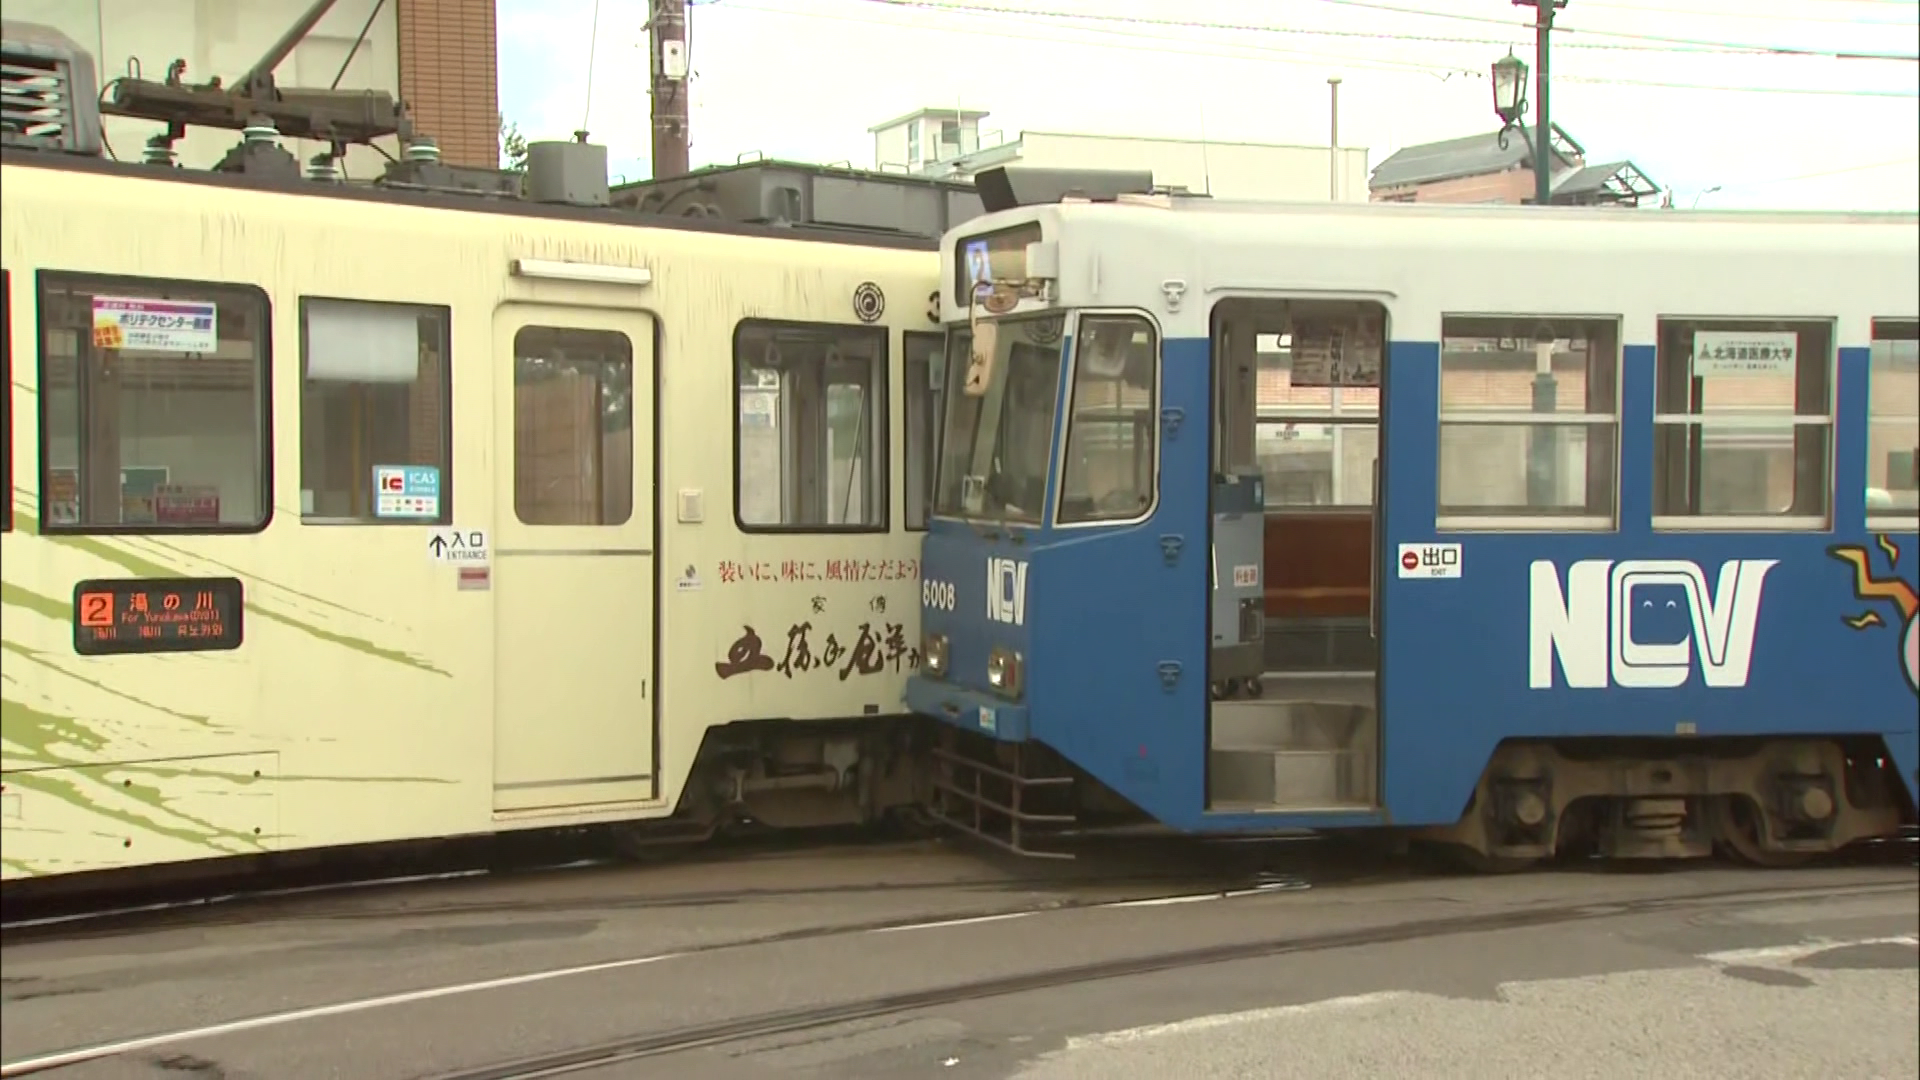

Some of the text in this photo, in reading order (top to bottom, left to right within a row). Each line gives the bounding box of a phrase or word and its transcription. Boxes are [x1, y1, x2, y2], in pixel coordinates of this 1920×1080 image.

[1714, 346, 1793, 361] 北海道医療大学
[410, 472, 436, 484] ICAS
[451, 531, 484, 548] 入口
[447, 550, 487, 560] ENTRANCE
[1422, 546, 1457, 566] 出口
[121, 612, 139, 624] For
[1530, 559, 1780, 688] NCV
